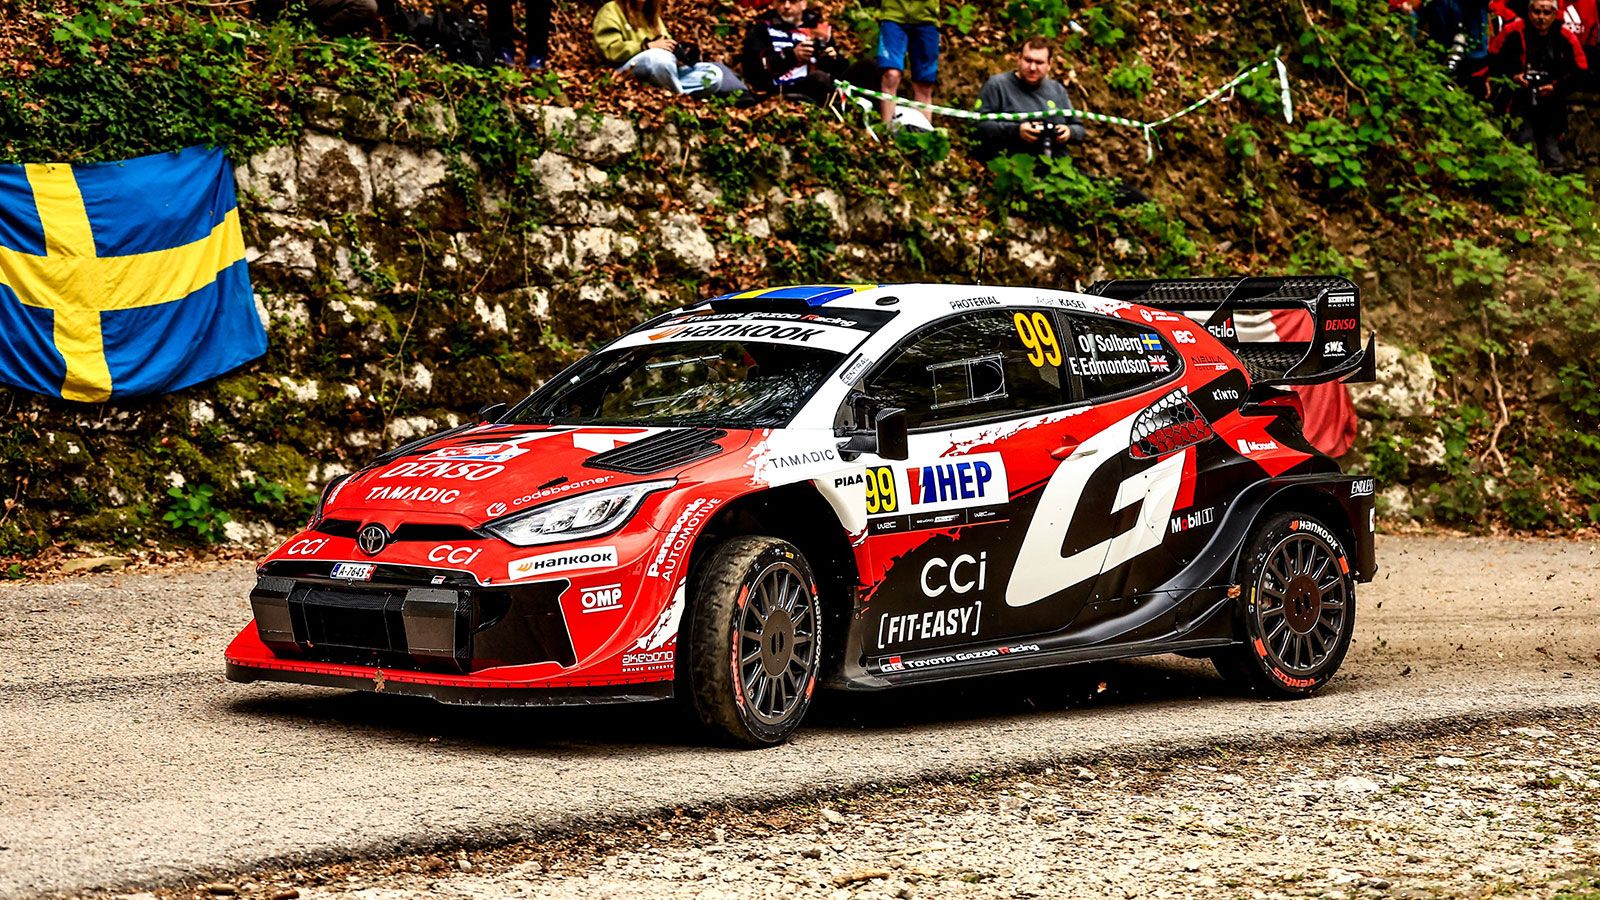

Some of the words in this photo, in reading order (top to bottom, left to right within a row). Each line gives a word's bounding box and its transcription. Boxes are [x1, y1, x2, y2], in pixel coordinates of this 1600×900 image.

[949, 295, 1000, 310] PROTERIAL
[1058, 298, 1087, 309] KASEI
[801, 314, 858, 327] Racing
[1207, 319, 1235, 338] Stilo
[1325, 318, 1357, 331] DENSO
[1013, 311, 1062, 367] 99
[1097, 333, 1144, 355] Solberg
[842, 358, 870, 384] CENTRAL
[769, 449, 835, 469] TAMADIC
[379, 462, 506, 481] DENSO
[834, 473, 864, 488] PIAA
[936, 460, 993, 502] HEP
[365, 486, 461, 505] TAMADIC
[512, 474, 611, 507] codebeamer
[866, 466, 898, 514] 99
[1171, 510, 1202, 534] Mobil
[647, 497, 707, 577] Panasonic
[662, 497, 722, 582] AUTOMOTIVE
[581, 587, 622, 608] OMP
[998, 643, 1040, 655] Racing
